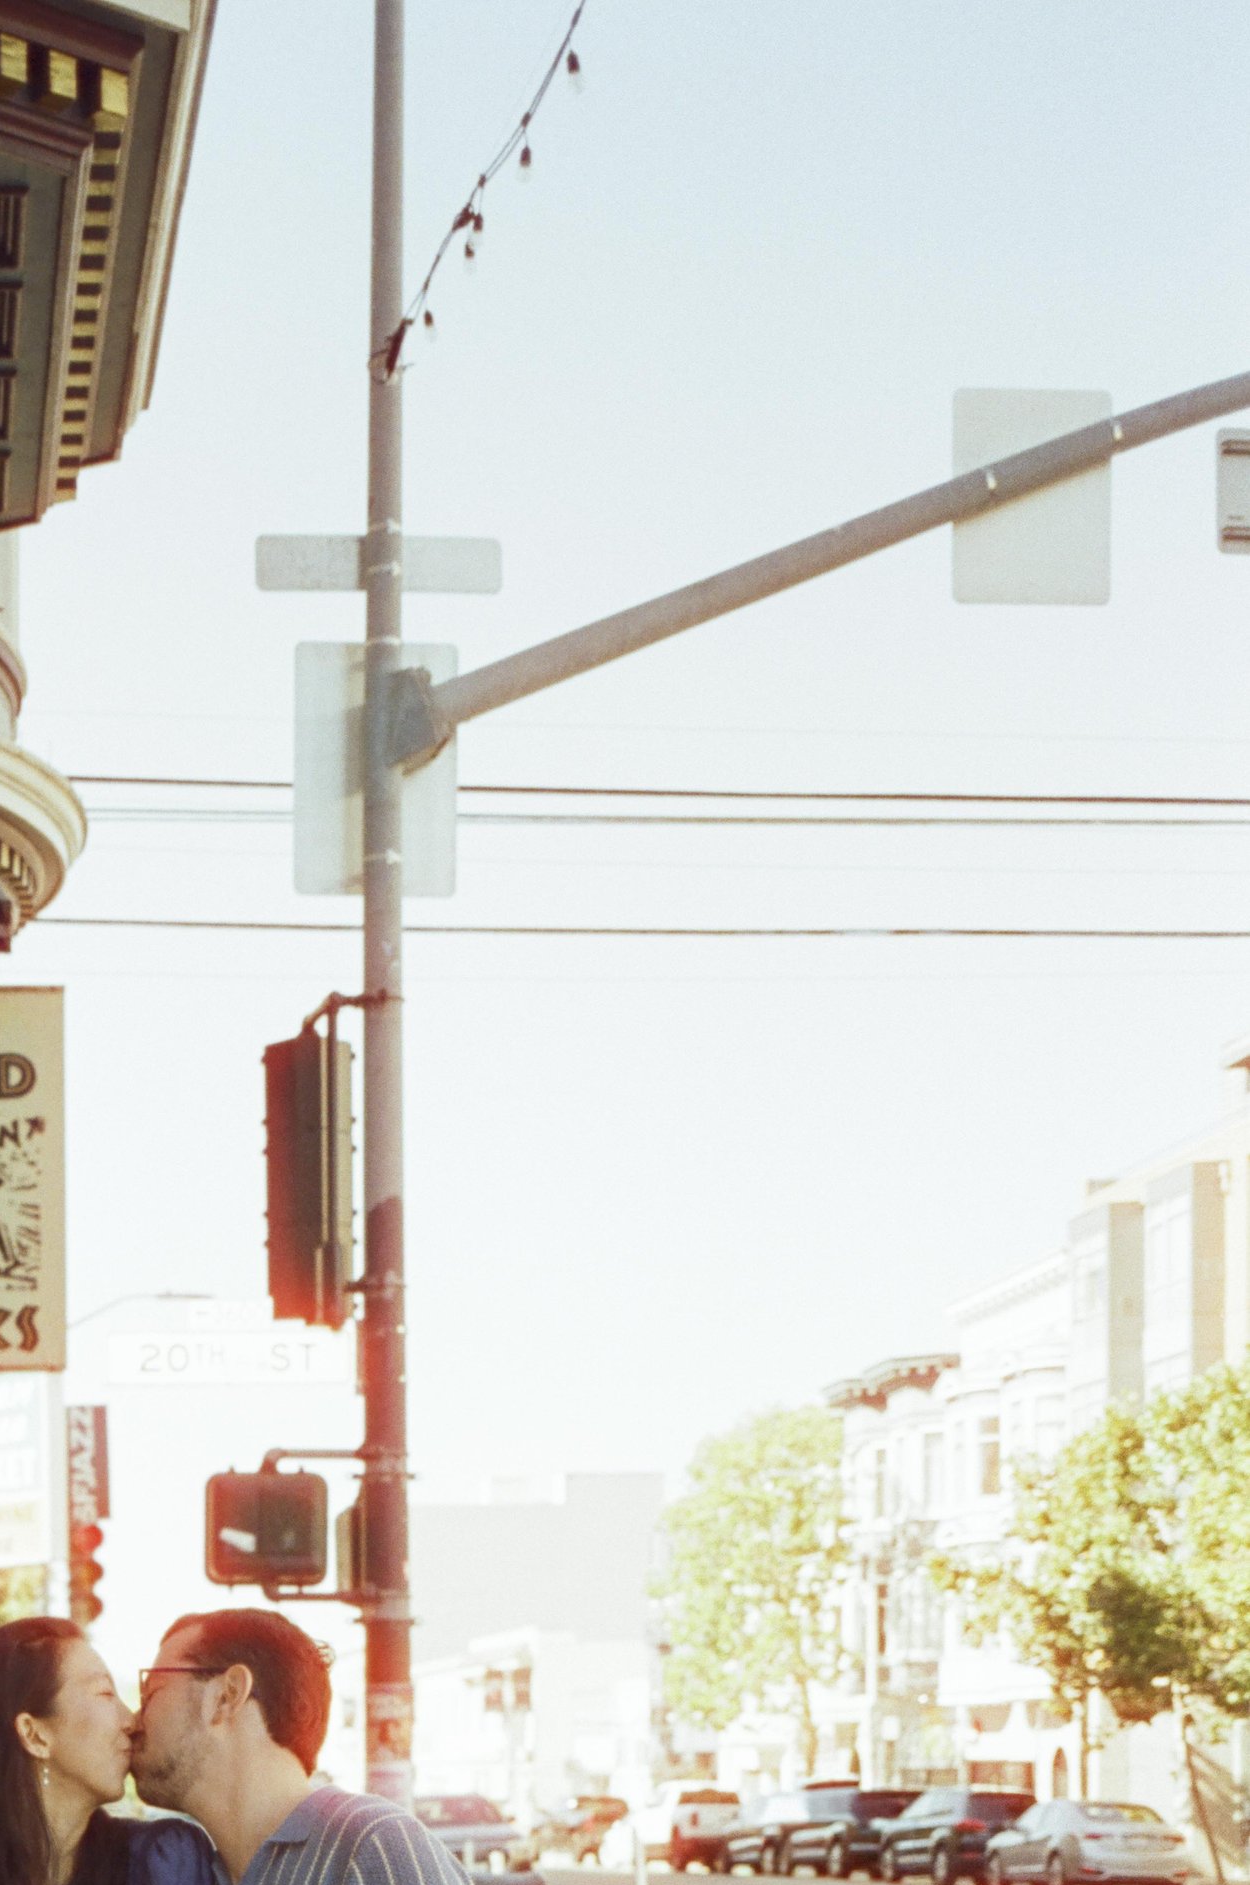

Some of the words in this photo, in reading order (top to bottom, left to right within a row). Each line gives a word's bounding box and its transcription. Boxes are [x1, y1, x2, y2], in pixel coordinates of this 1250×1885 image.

[139, 1343, 226, 1374] 20TH
[270, 1342, 316, 1373] ST
[70, 1407, 98, 1524] SFJAZZ
